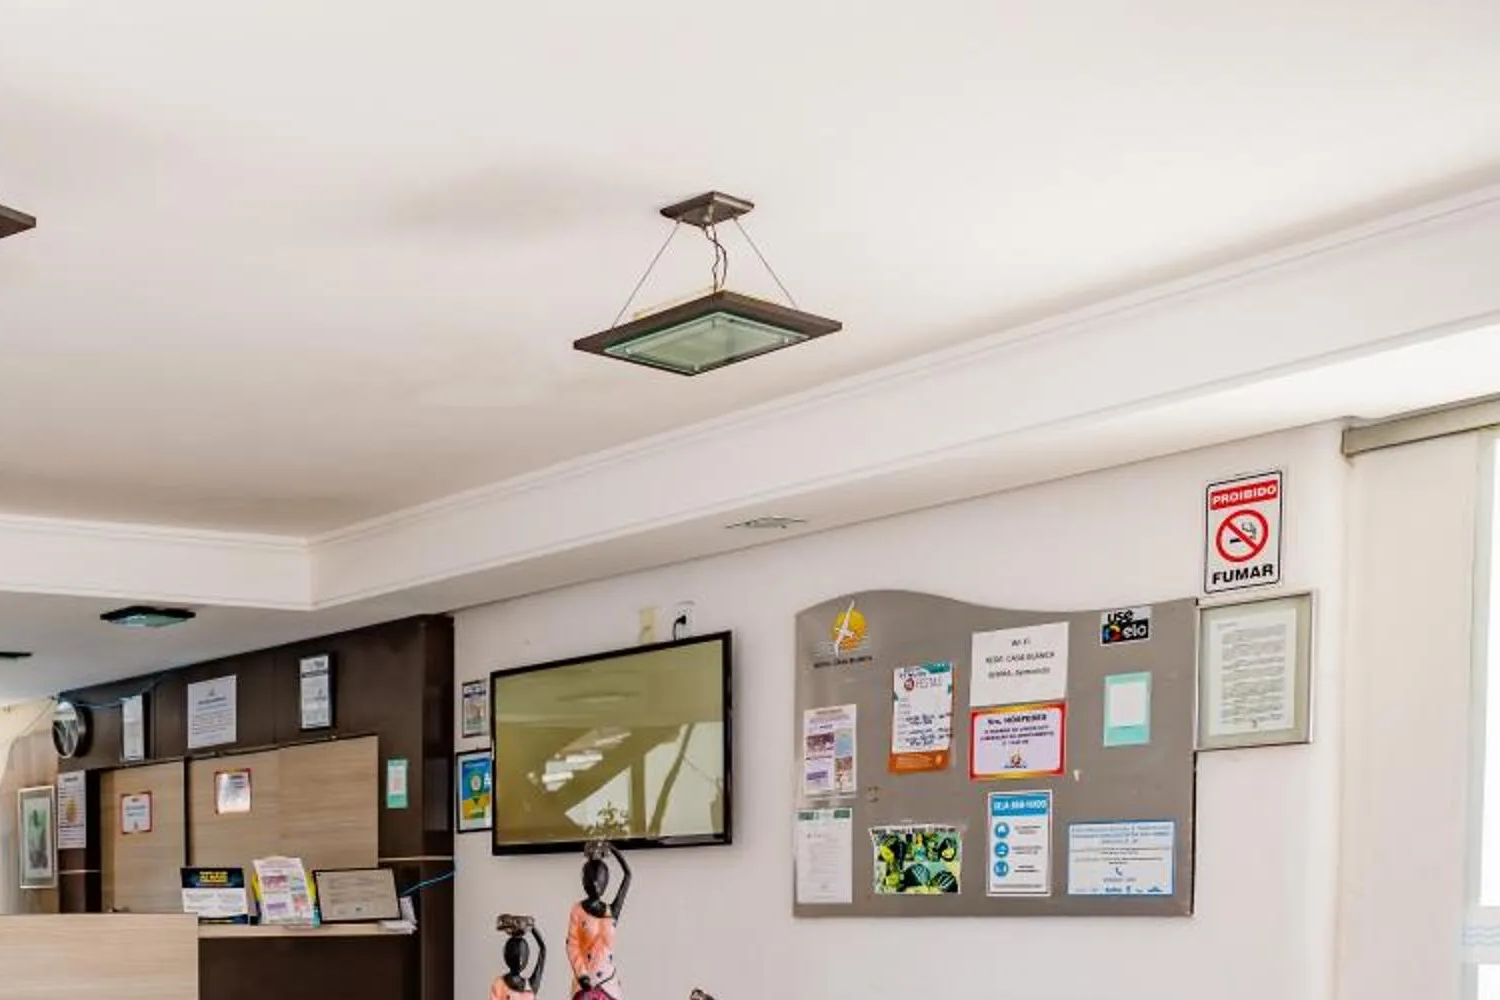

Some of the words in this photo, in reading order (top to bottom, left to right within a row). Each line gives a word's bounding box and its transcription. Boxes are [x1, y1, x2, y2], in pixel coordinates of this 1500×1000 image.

[1211, 485, 1277, 505] PROIBIDO
[1212, 564, 1274, 585] FUMAR
[1107, 610, 1133, 625] use
[1121, 623, 1147, 639] elo
